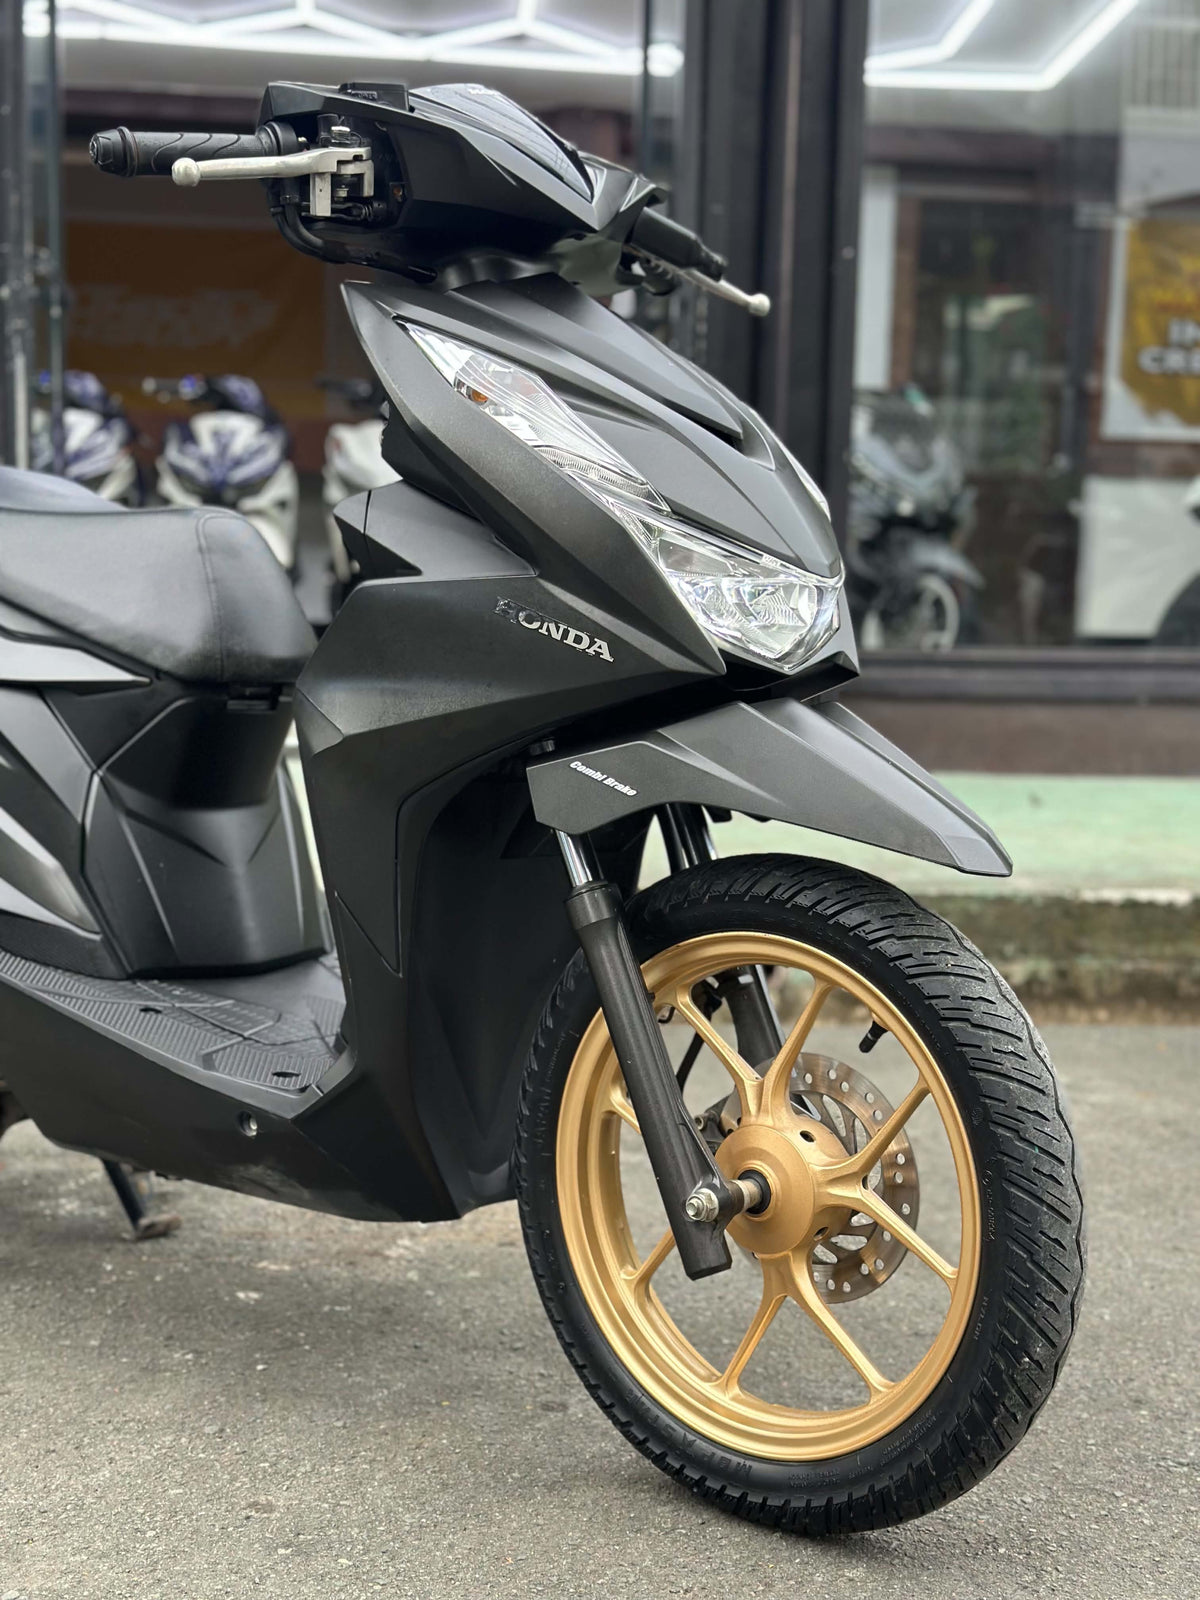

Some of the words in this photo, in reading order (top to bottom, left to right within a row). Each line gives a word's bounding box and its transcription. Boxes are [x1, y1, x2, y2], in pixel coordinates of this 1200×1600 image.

[494, 597, 614, 662] HONDA
[569, 761, 607, 781] Combi
[602, 777, 637, 796] Brake
